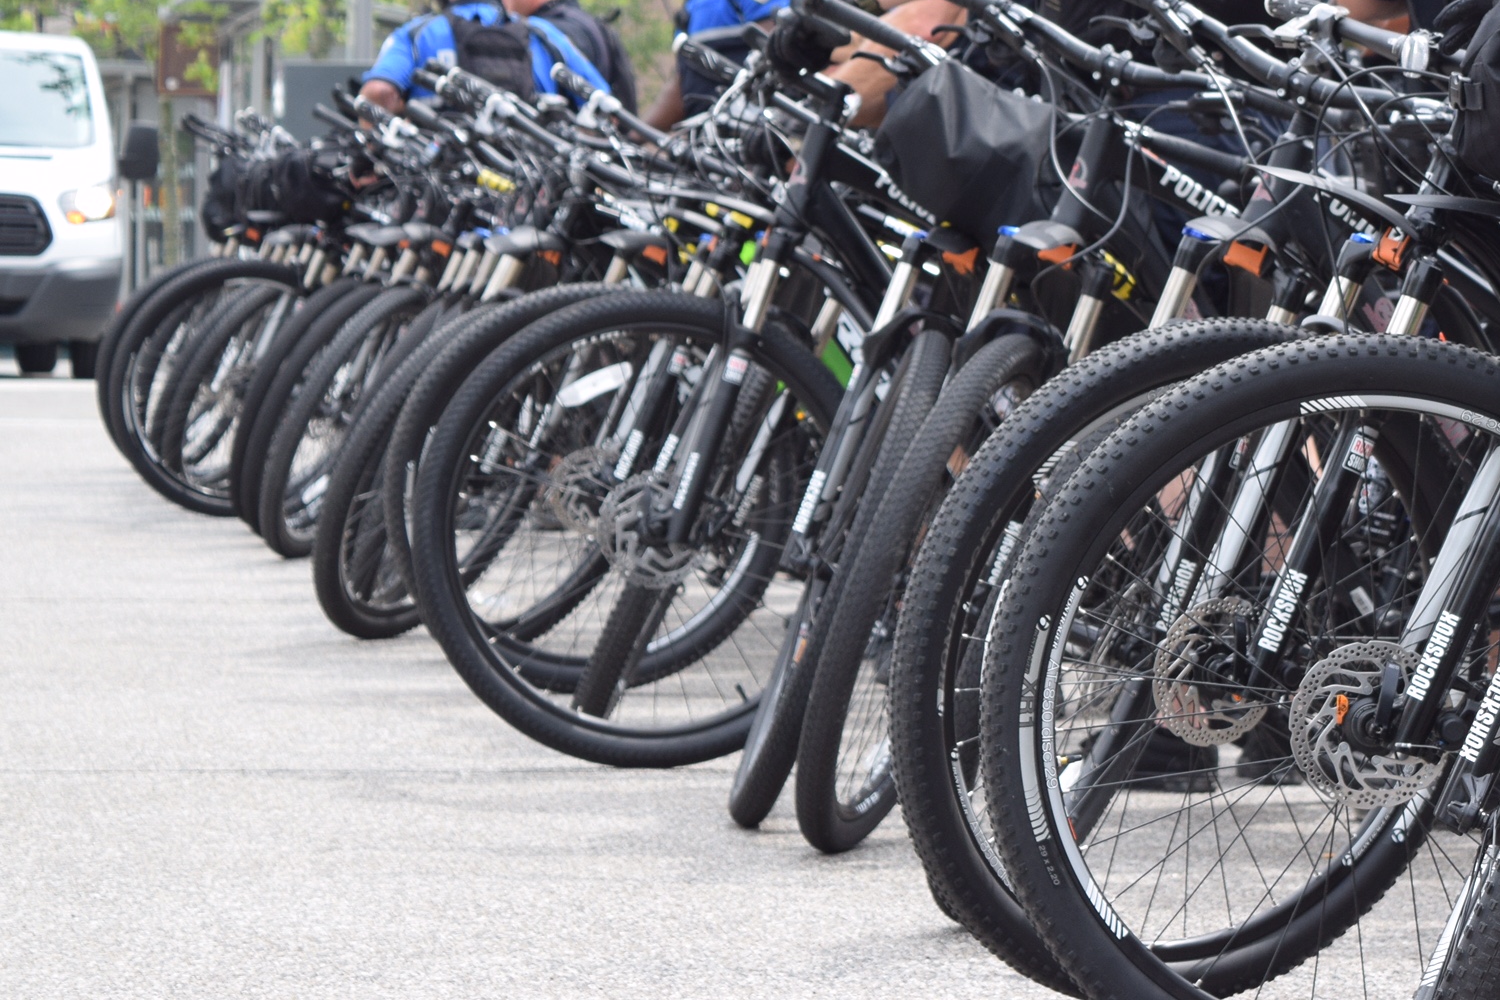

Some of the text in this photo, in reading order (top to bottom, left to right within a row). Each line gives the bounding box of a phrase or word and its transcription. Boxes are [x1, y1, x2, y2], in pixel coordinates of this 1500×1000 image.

[1258, 568, 1308, 653] ROCKSHOX
[1406, 610, 1461, 701] ROCKSHOX
[1019, 679, 1038, 728] XR1
[1041, 658, 1060, 789] AT-850 disc 29
